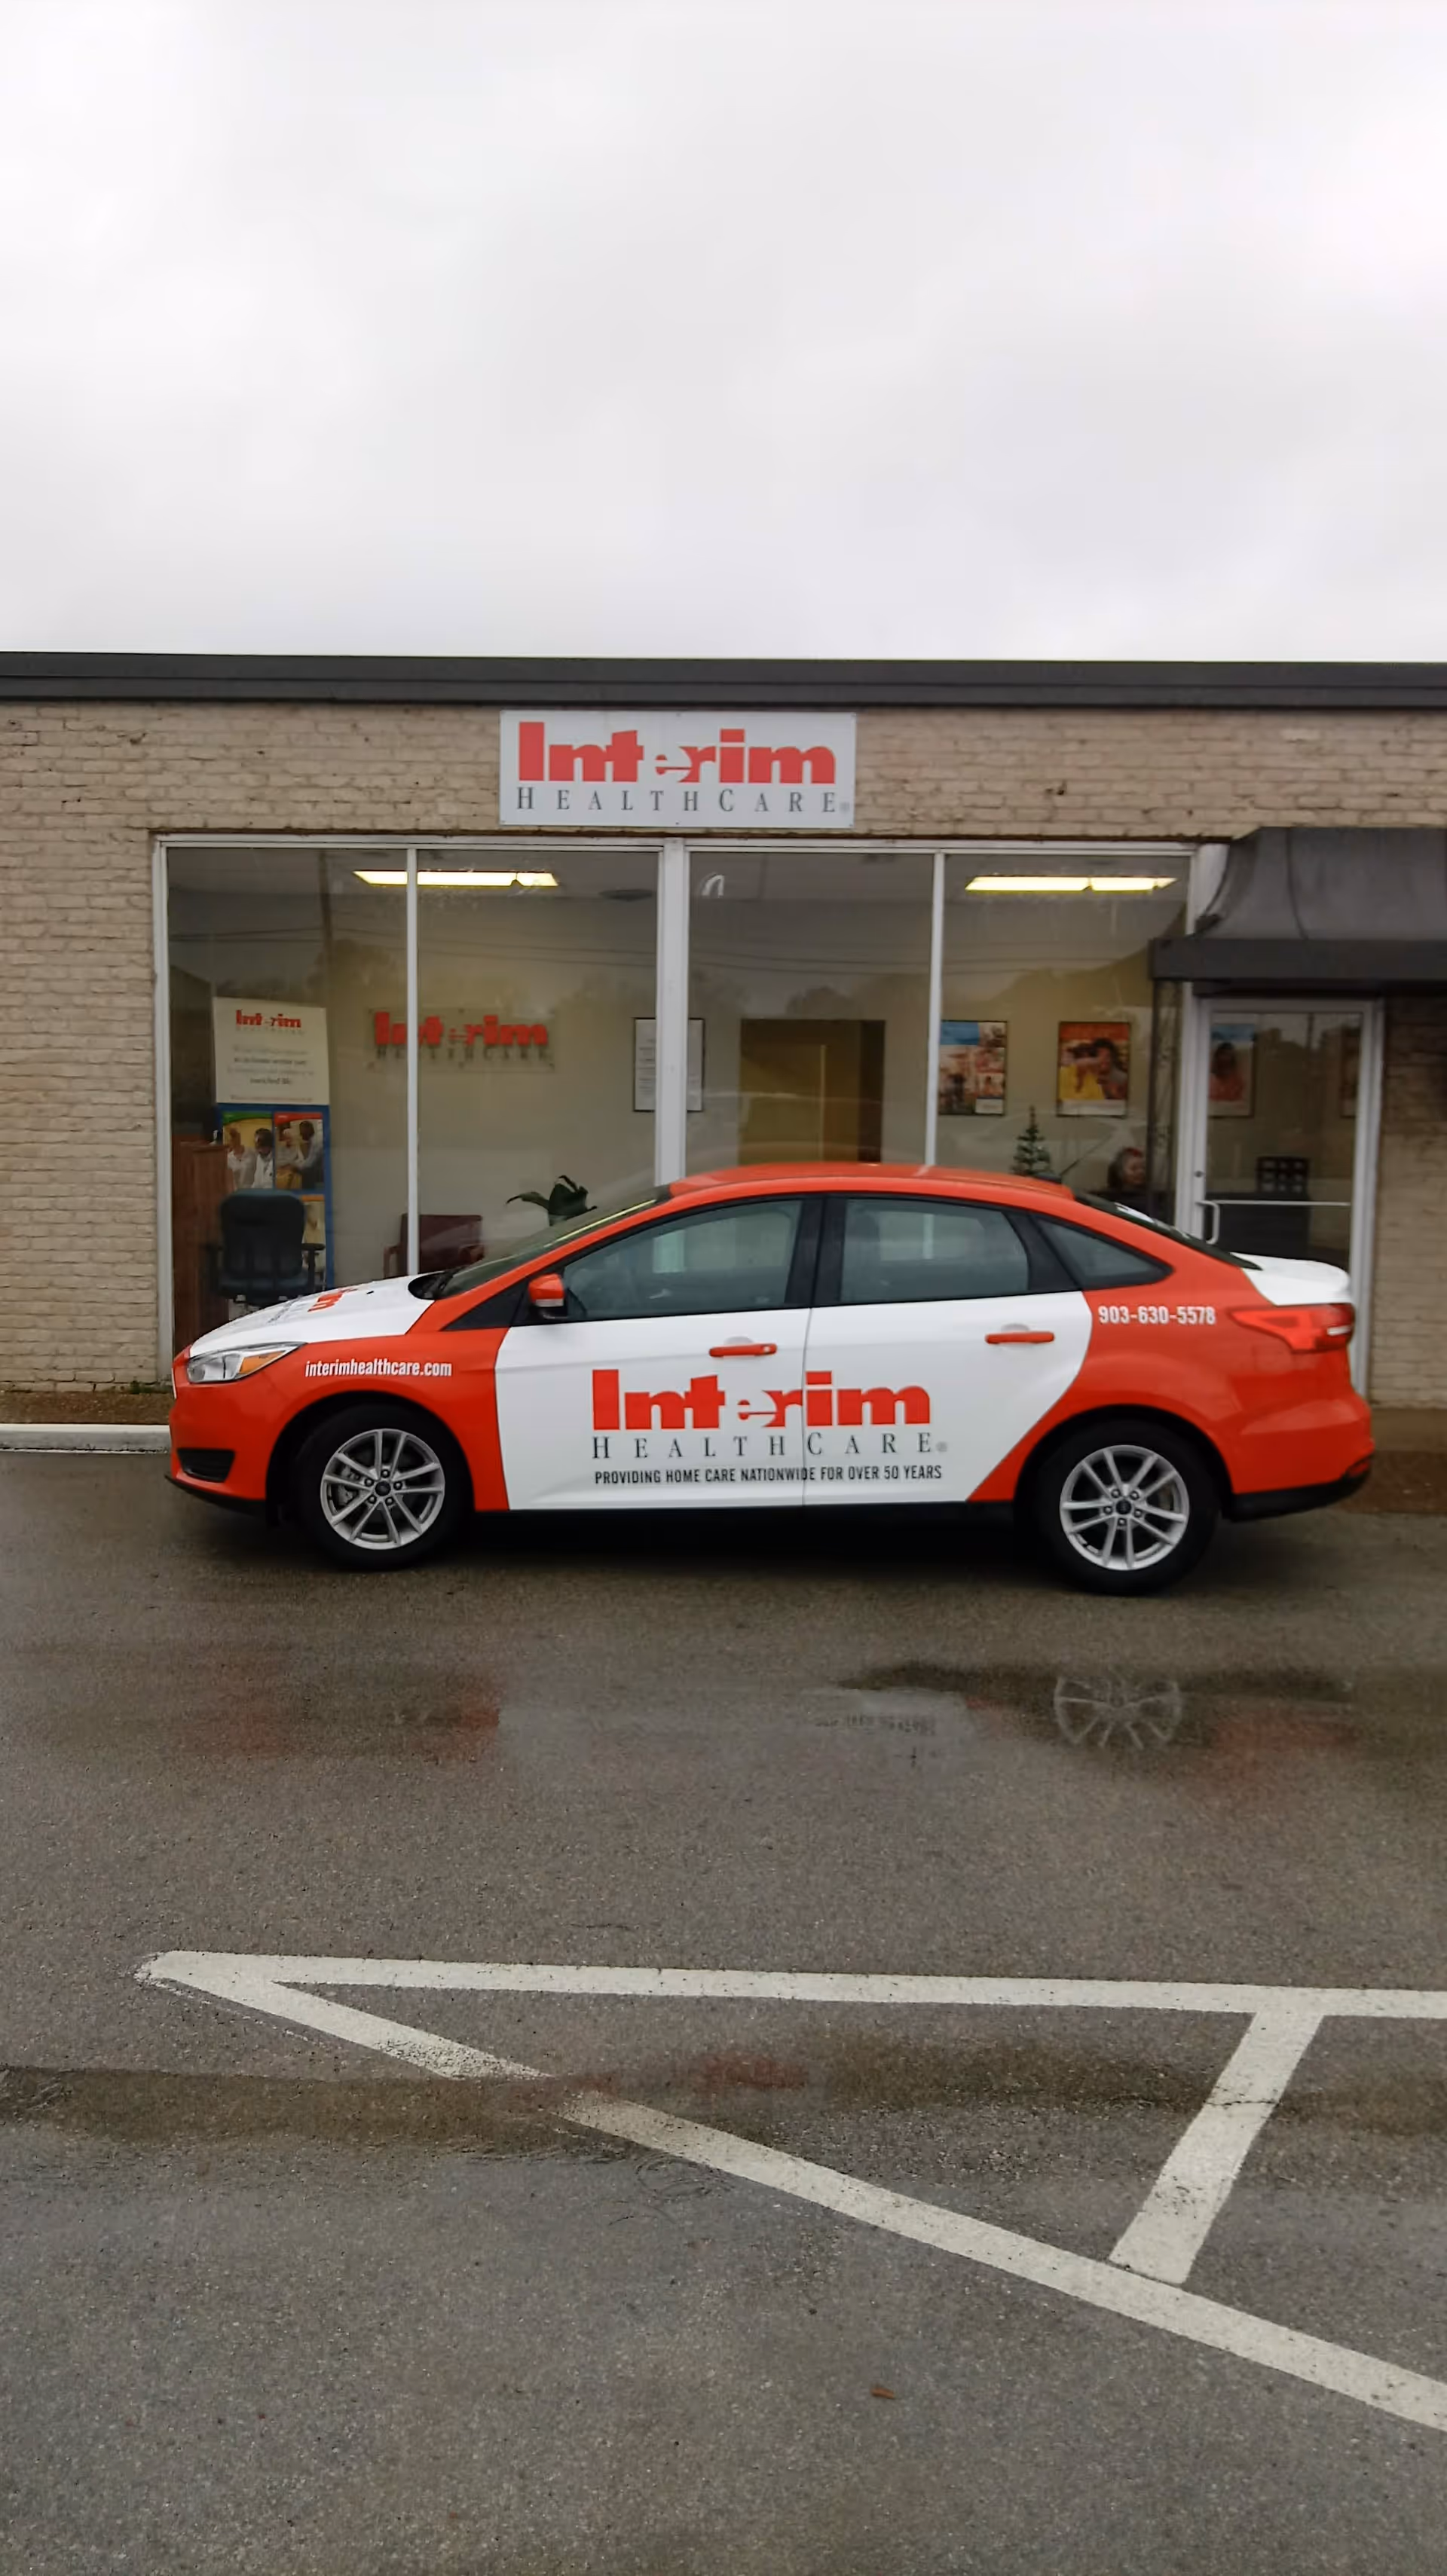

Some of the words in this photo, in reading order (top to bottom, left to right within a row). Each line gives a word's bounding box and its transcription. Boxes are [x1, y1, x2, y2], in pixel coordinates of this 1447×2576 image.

[519, 721, 836, 784] Interim
[516, 787, 836, 812] HEALTHCARE
[1097, 1305, 1216, 1325] 903-630-5578
[304, 1358, 452, 1377] interimhealthcare.com
[592, 1368, 931, 1430] Interim
[592, 1432, 932, 1459] HEALTHCARE
[594, 1470, 661, 1484] PROVIDING
[665, 1468, 701, 1483] HOME
[705, 1468, 736, 1482] CARE
[740, 1467, 816, 1481] NATIONWIDE
[820, 1466, 843, 1481] FOR
[848, 1465, 880, 1480] OVER
[883, 1465, 898, 1480] 50
[904, 1465, 942, 1479] YEARS
